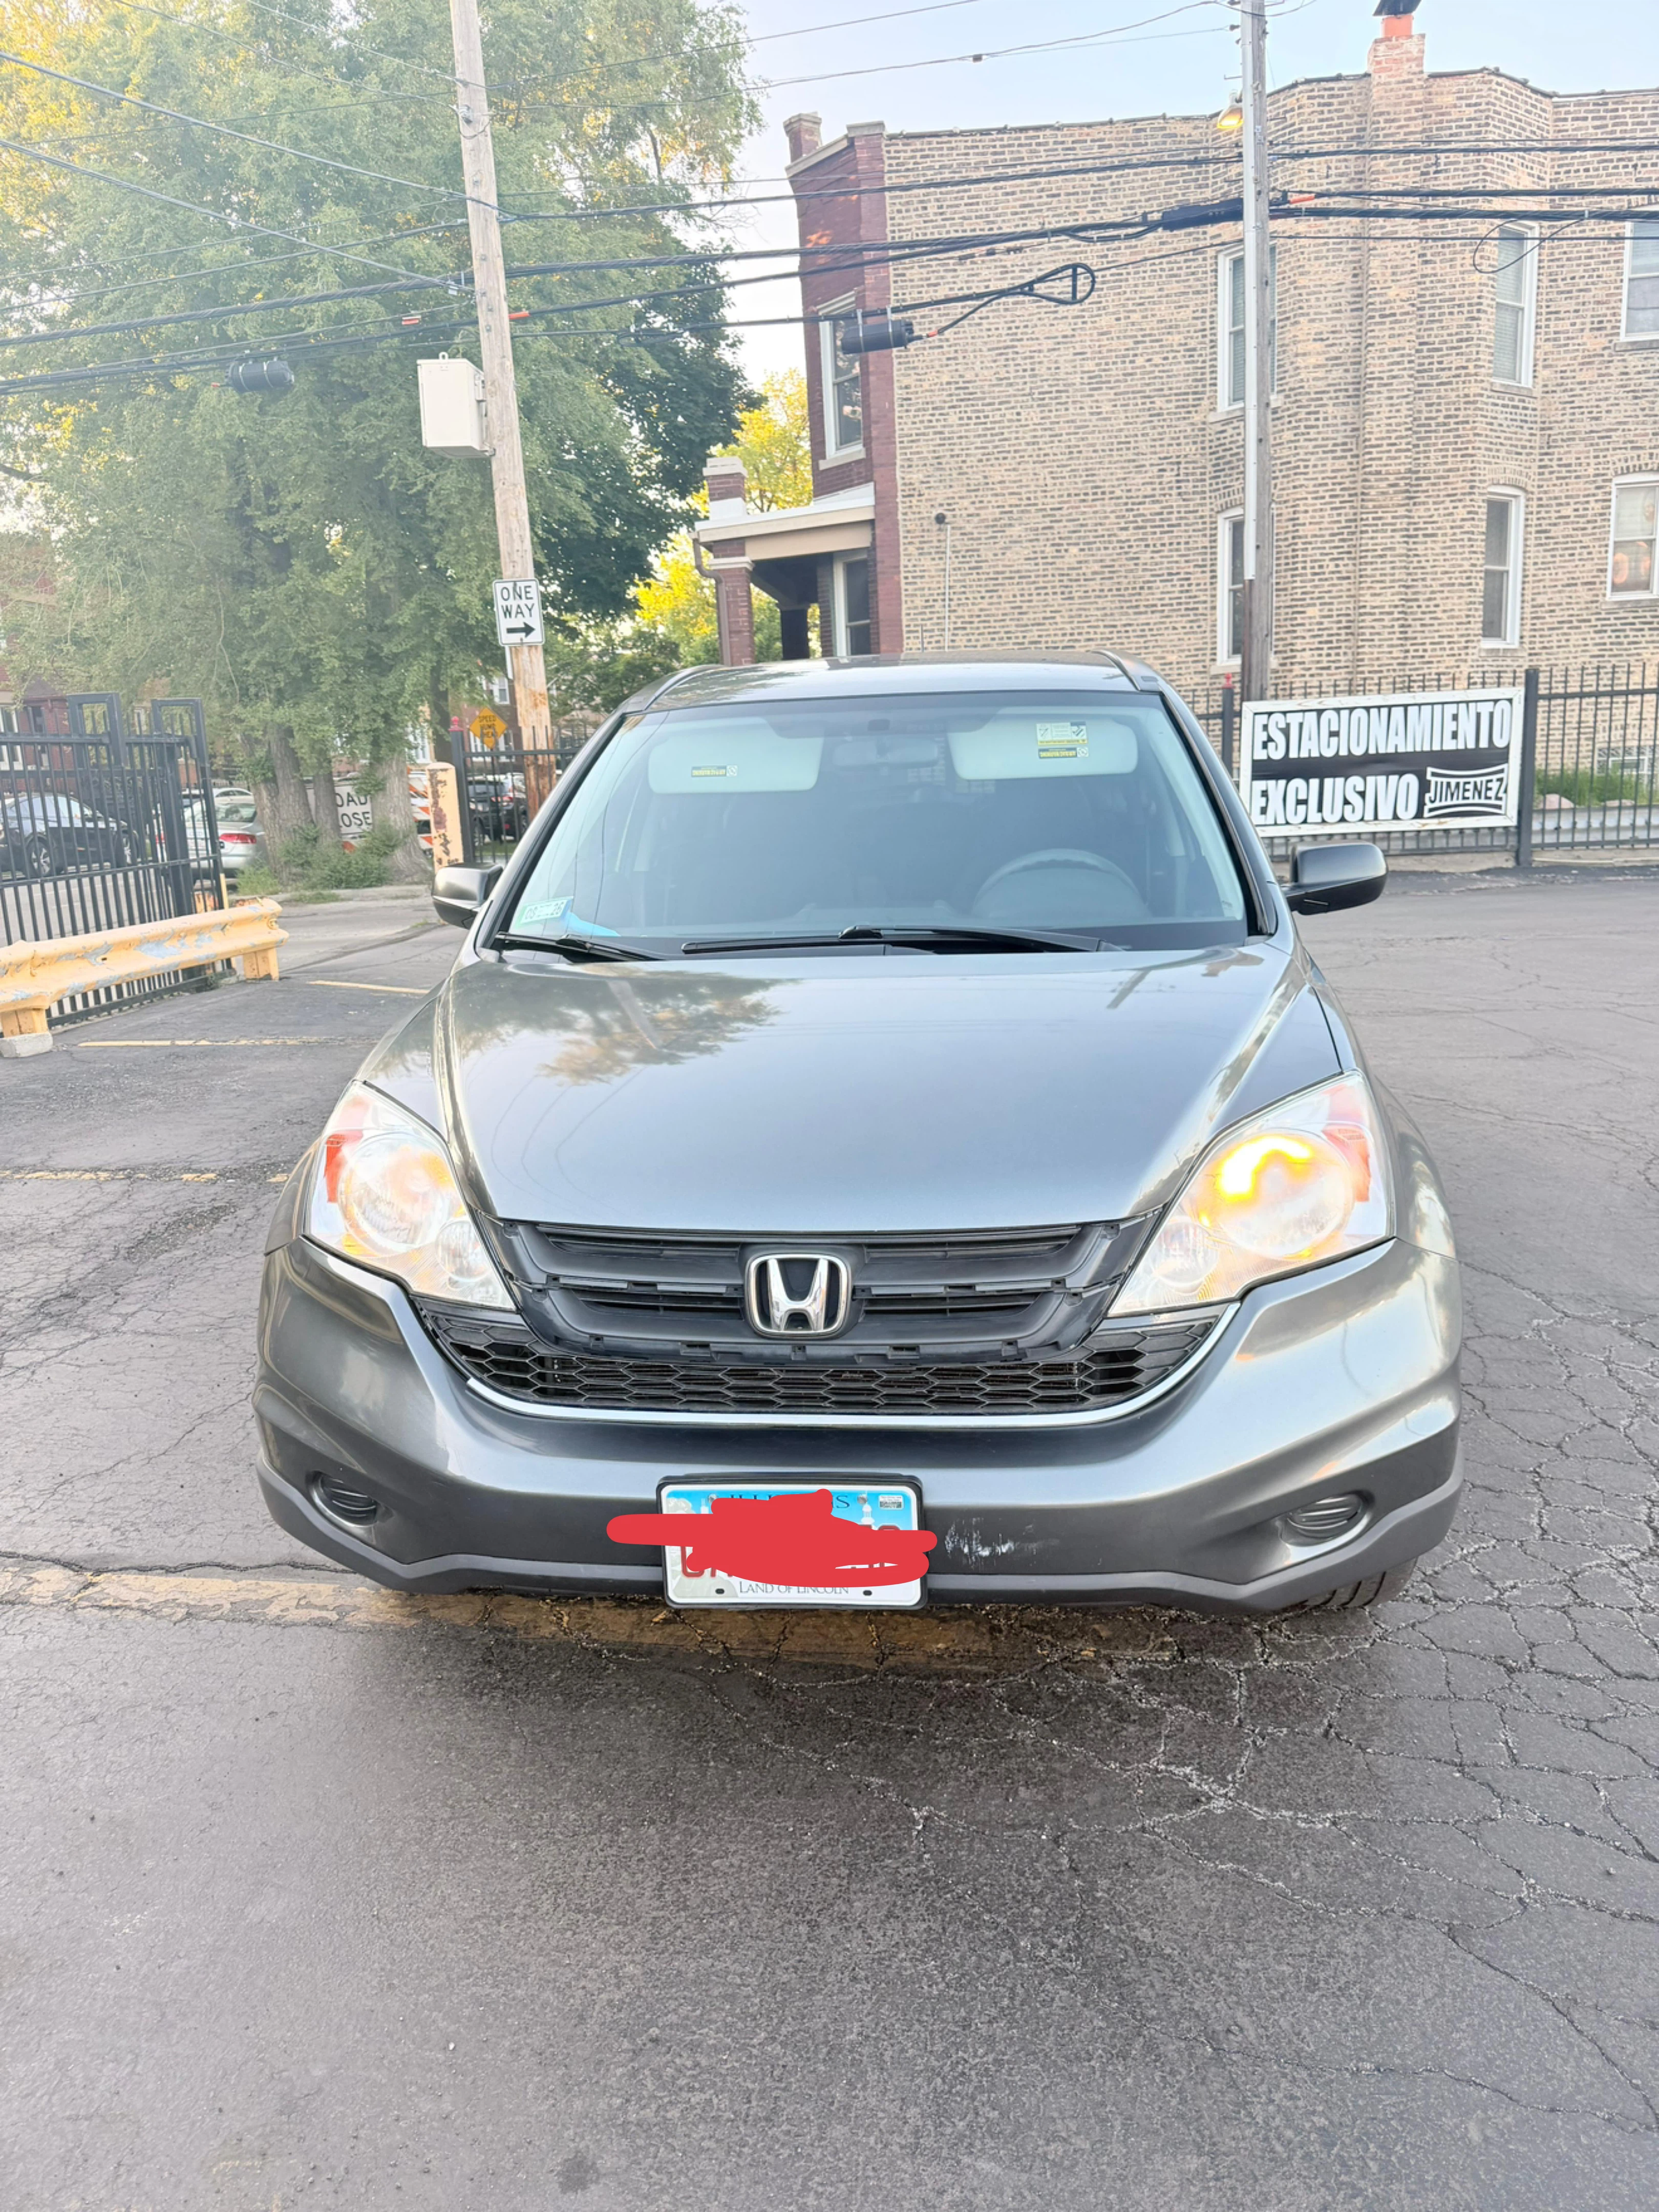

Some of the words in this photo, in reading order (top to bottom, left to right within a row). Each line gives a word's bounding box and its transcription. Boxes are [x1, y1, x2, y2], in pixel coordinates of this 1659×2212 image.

[501, 585, 533, 601] ONE
[501, 603, 535, 619] WAY
[1252, 699, 1512, 760] ESTACIONAMIENTO
[335, 792, 368, 807] OAD
[1252, 774, 1419, 825] EXCLUSIVO
[1429, 777, 1504, 804] JIMENEZ
[340, 812, 372, 828] OSE
[740, 1581, 774, 1594] LAND
